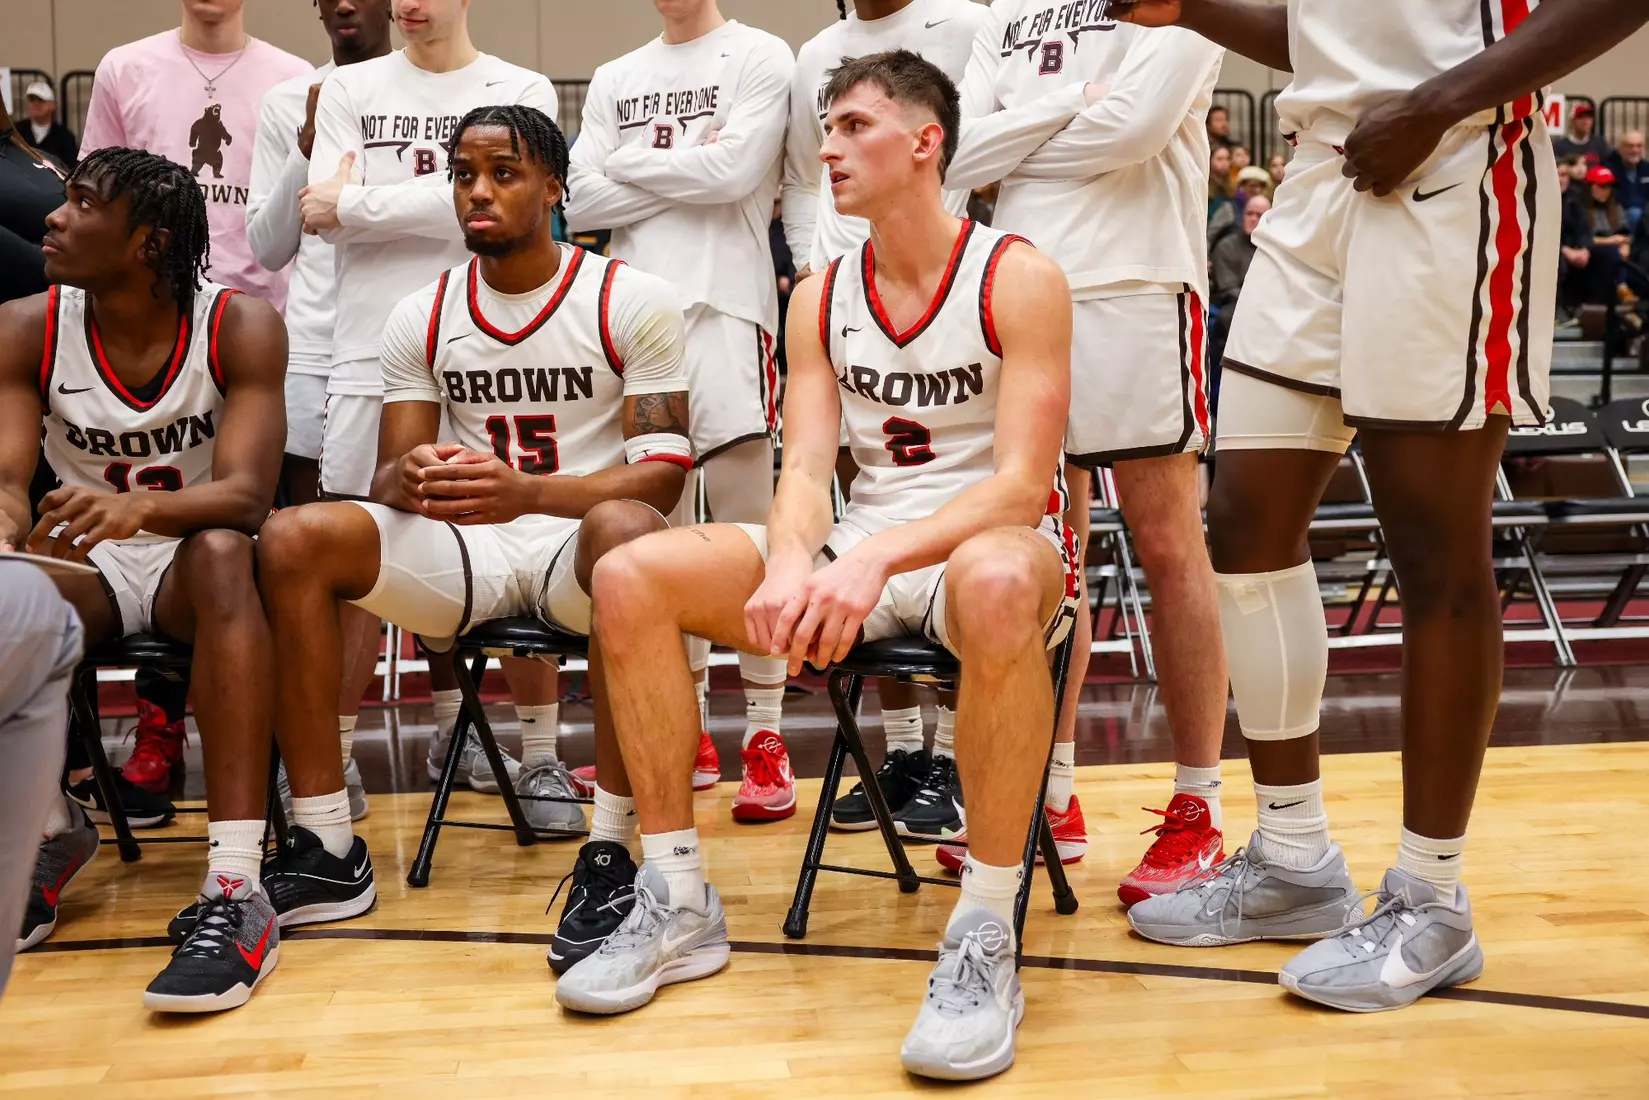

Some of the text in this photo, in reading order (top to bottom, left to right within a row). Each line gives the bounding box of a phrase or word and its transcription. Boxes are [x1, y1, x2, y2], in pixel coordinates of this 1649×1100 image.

[1002, 16, 1028, 49] NOT
[1039, 40, 1063, 76] B
[617, 97, 638, 122] NOT
[643, 92, 660, 119] FR
[361, 114, 463, 140] NOT FOR EVER
[652, 123, 675, 149] B
[413, 148, 438, 177] B
[443, 366, 594, 403] BROWN
[63, 409, 215, 457] BROWN
[485, 414, 560, 477] 15
[882, 416, 936, 467] 2
